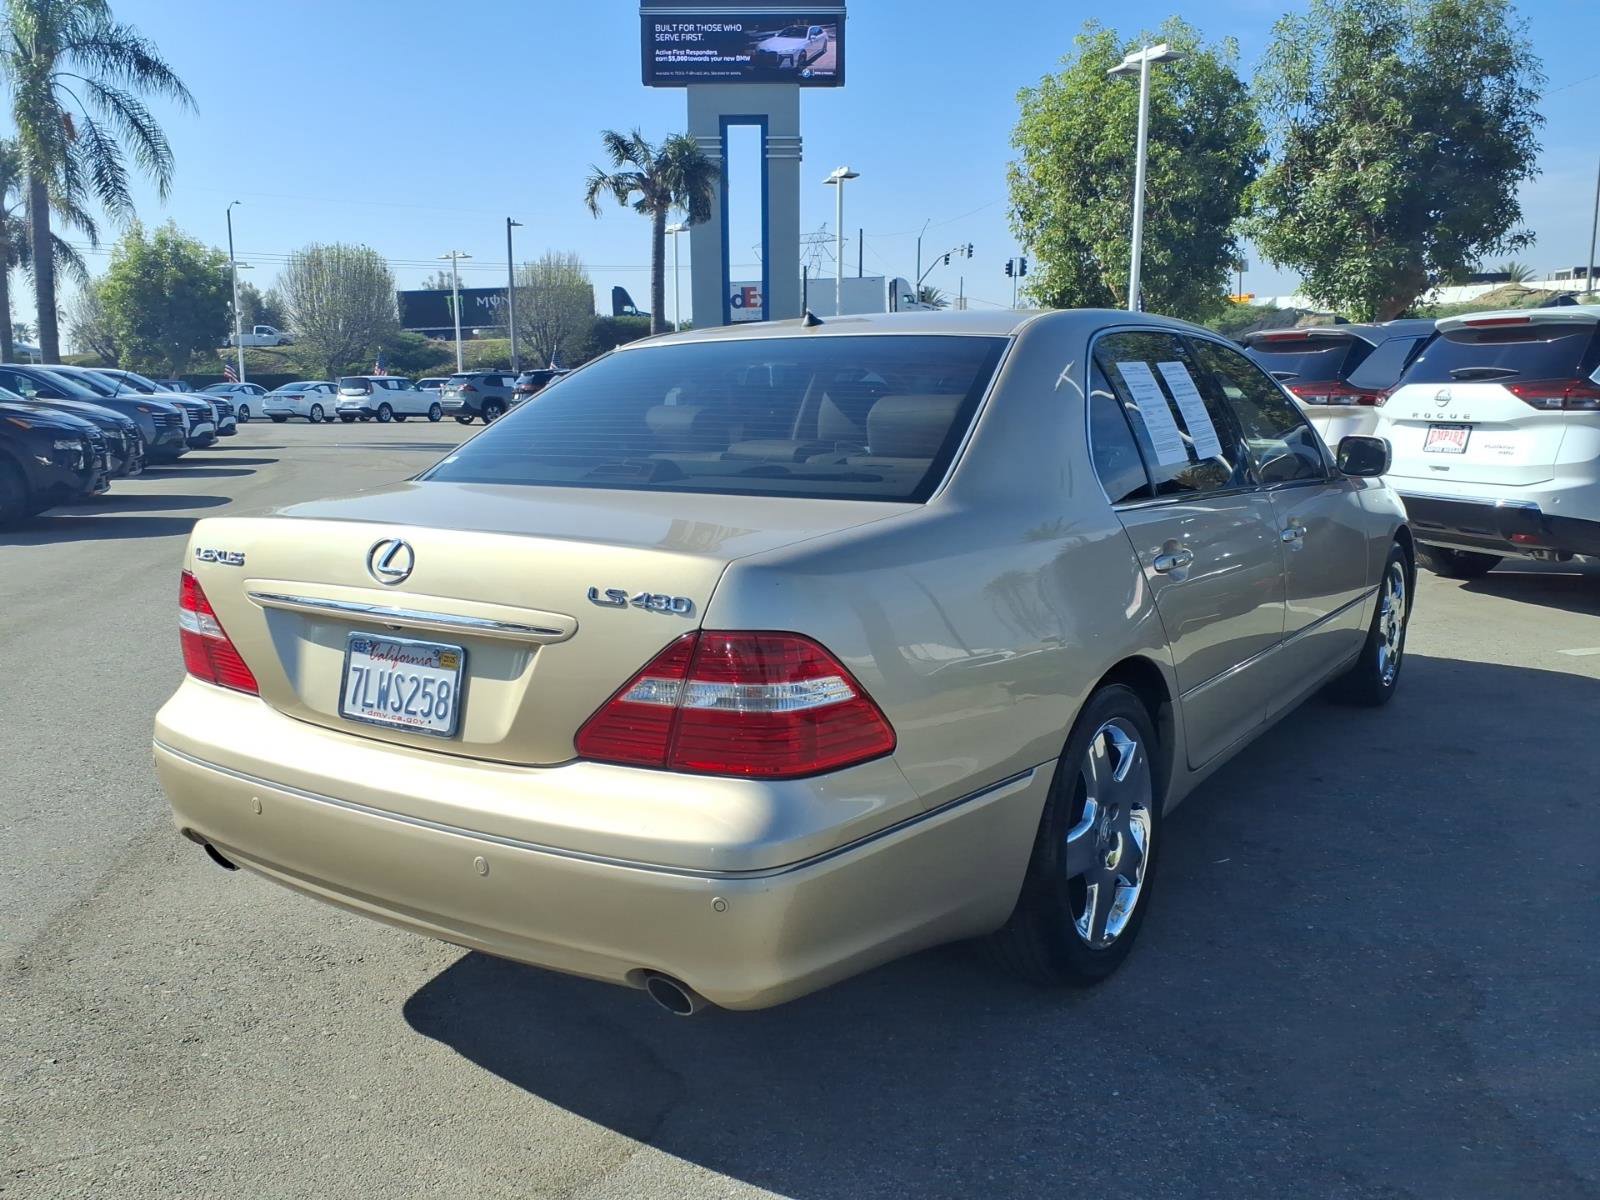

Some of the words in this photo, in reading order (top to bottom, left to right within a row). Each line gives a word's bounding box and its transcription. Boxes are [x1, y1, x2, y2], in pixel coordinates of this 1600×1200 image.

[655, 24, 677, 32] BUILT
[678, 24, 695, 32] FOR
[696, 24, 722, 32] THOSE
[723, 24, 742, 32] WHO
[655, 33, 680, 41] SERVE
[681, 33, 704, 41] FIRST.
[1412, 412, 1471, 420] ROGUE
[1428, 430, 1466, 447] EMPIRE
[195, 547, 245, 567] LEXUS
[588, 587, 628, 606] LS
[629, 592, 692, 613] 430
[368, 640, 432, 669] California
[351, 666, 450, 720] 7LWS258
[367, 710, 426, 726] dmv.ca.gov
